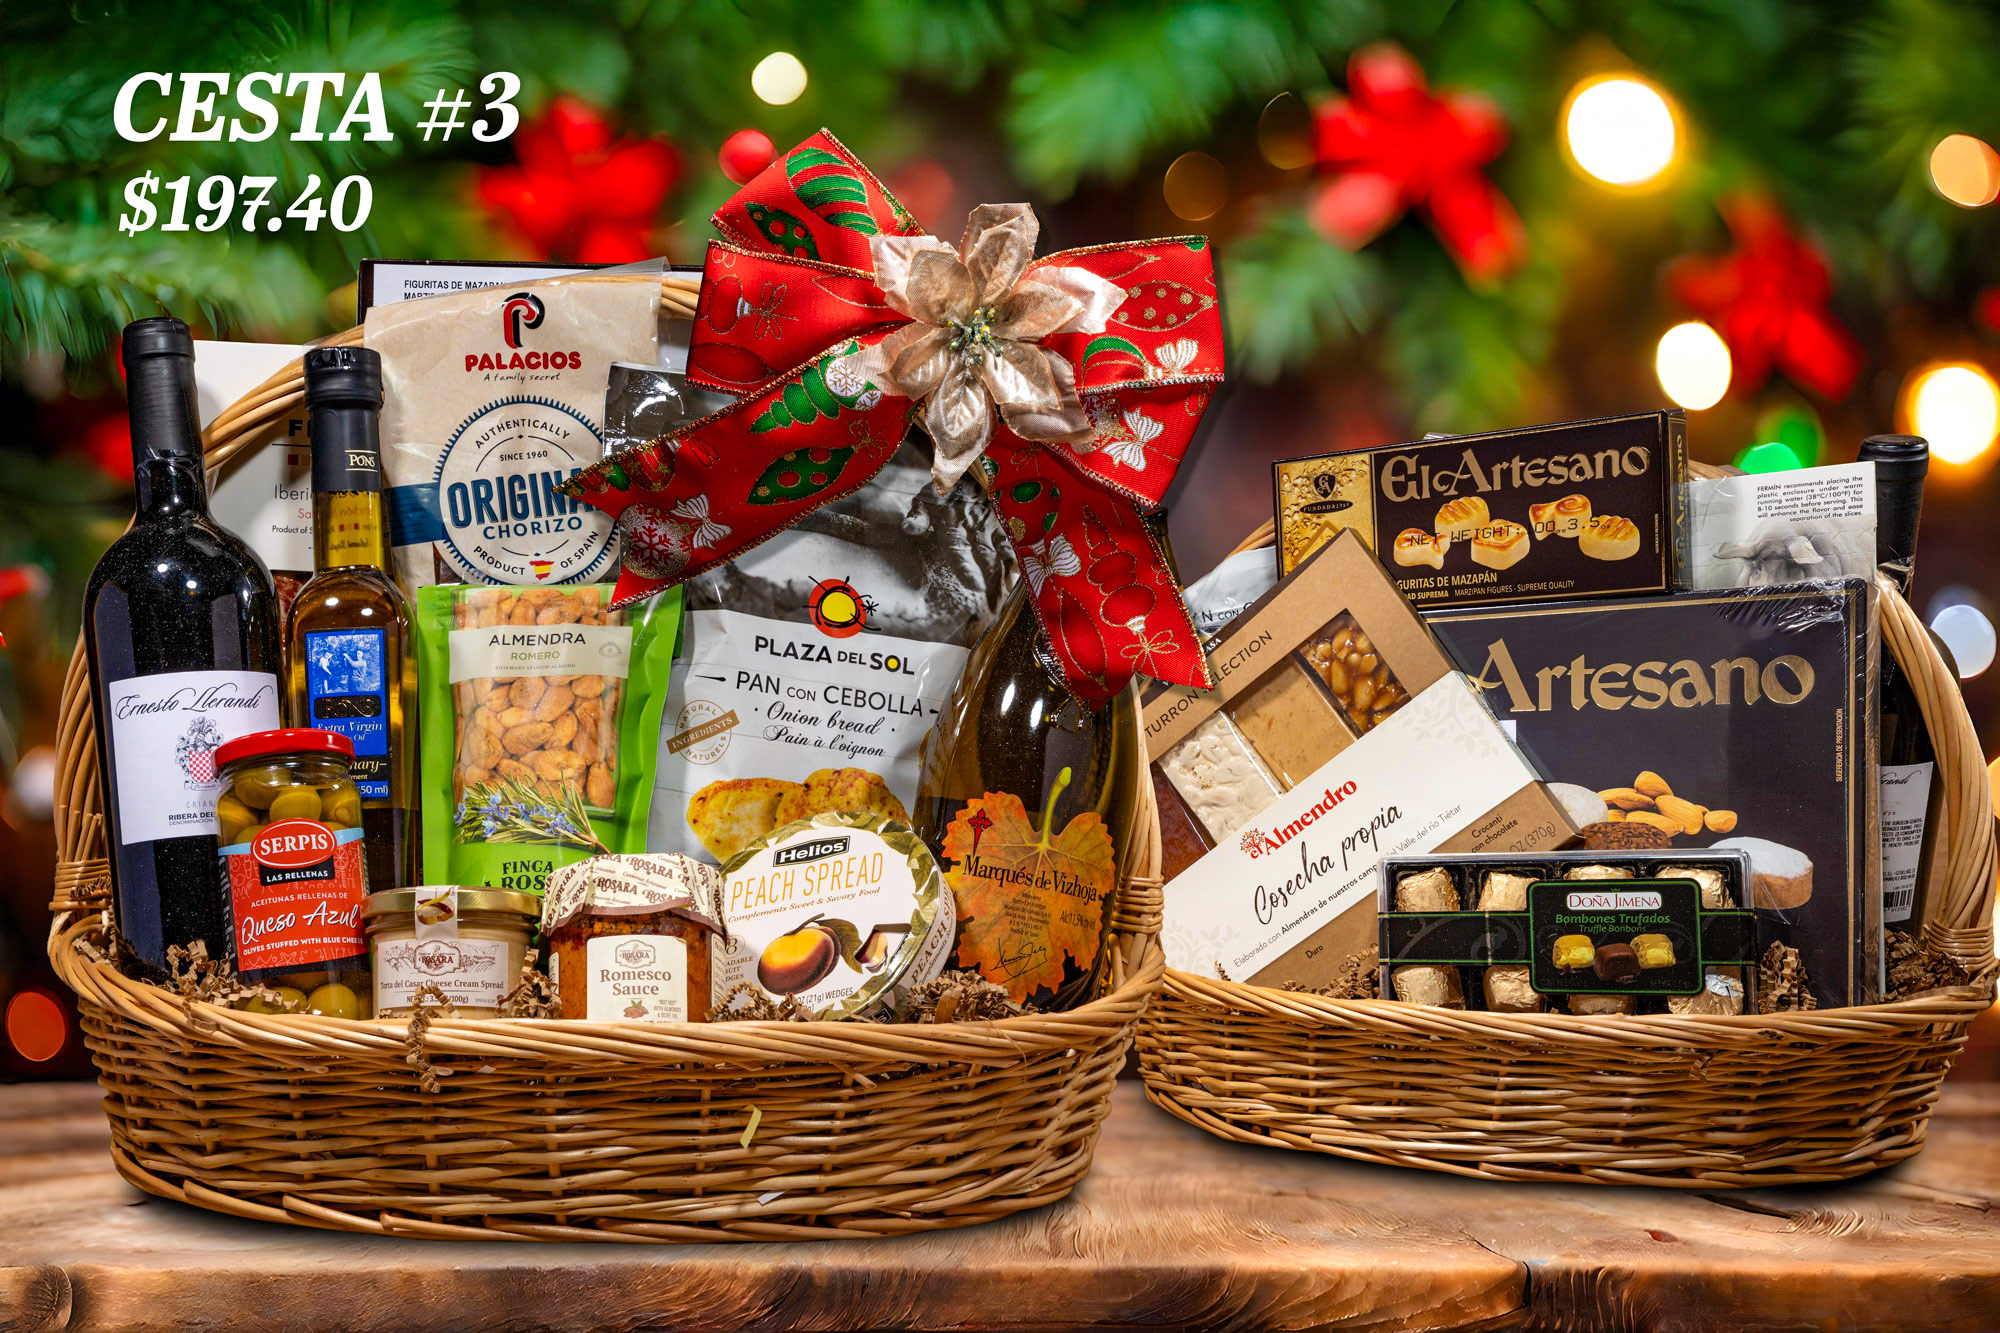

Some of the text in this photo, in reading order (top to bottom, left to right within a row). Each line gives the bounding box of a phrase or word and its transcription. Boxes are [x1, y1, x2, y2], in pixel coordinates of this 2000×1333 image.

[404, 280, 463, 289] FIGURITAS DE
[465, 351, 582, 373] PALACIOS
[484, 372, 561, 385] A family secret
[475, 418, 571, 449] AUTHENTICALLY
[348, 454, 376, 468] PONS
[500, 450, 548, 462] SINCE 1960
[1380, 444, 1651, 503] El Artesano
[1783, 480, 1824, 489] recommends
[1826, 477, 1850, 486] placing
[447, 467, 602, 530] ORIGINA
[1757, 490, 1778, 500] plastic
[1782, 488, 1815, 496] enclosure
[1800, 500, 1822, 508] before
[272, 525, 299, 535] Product
[299, 525, 308, 534] of
[483, 516, 583, 540] CHORIZO
[1410, 531, 1441, 547] NET
[473, 530, 599, 576] PRODUCT OF SPAIN
[1396, 570, 1498, 591] GURITAS DE MAZAPÁN
[1417, 579, 1575, 599] SUPREMA MARZIPAN FIGURES SUPREME QUALITY
[1217, 609, 1240, 621] CON
[489, 632, 586, 647] ALMENDRA
[510, 650, 560, 661] ROMERO
[754, 635, 915, 676] PLAZA DEL SOL
[1144, 629, 1273, 739] TURRON LECTION
[1475, 638, 1815, 712] Artesano
[115, 682, 274, 720] Ernesto Llerandi
[736, 671, 923, 717] PAN CON CEBOLLA
[679, 703, 717, 729] NATURAL
[767, 700, 885, 736] Onion bread
[349, 720, 383, 734] Virgin
[672, 716, 733, 749] INGREDIENTS
[763, 724, 809, 746] Pain
[686, 734, 727, 761] NATURELS
[374, 784, 389, 795] ml)
[168, 812, 198, 821] RIBERA
[1263, 777, 1358, 857] Almendro
[1471, 813, 1504, 839] Crocanti
[260, 832, 328, 856] SERPIS
[1471, 818, 1519, 854] con chocolate
[1525, 821, 1557, 848] (370g)
[779, 839, 846, 863] Helios
[502, 859, 554, 875] FINCA
[626, 856, 673, 880] ROSARA
[1253, 802, 1404, 926] Cosecha propia
[266, 869, 329, 883] LAS RELLENAS
[501, 874, 546, 891] ROS
[593, 876, 638, 895] ROSARA
[730, 868, 796, 913] PEACH
[803, 852, 884, 896] SPREAD
[962, 854, 1098, 905] Marqués de Vizhoja
[1233, 804, 1462, 968] Elaborado con Almendras de nuestros Valle del Tiétar
[250, 895, 295, 908] ACEITUNAS
[297, 892, 337, 900] RELLENAS
[728, 886, 881, 923] Complements Sweet & Savory Food
[1569, 893, 1661, 910] DOÑA JIMENA
[241, 901, 359, 945] Queso Azul
[1555, 913, 1671, 925] Bombones Trufados
[1579, 924, 1647, 934] Truffle Bonbons
[243, 936, 363, 955] OLIVES STUFFED WITH BLUE CHEESE
[725, 937, 738, 955] 8
[1305, 945, 1324, 960] Duro
[419, 955, 454, 966] ROSARA
[619, 951, 650, 962] ROSARA
[380, 981, 393, 989] Torta
[394, 980, 404, 988] del
[404, 980, 424, 988] Casar
[454, 980, 479, 988] Cream
[480, 981, 504, 990] Spread
[600, 969, 672, 983] Romesco
[612, 982, 659, 996] Sauce
[806, 986, 854, 1004] (21g) WEDGES
